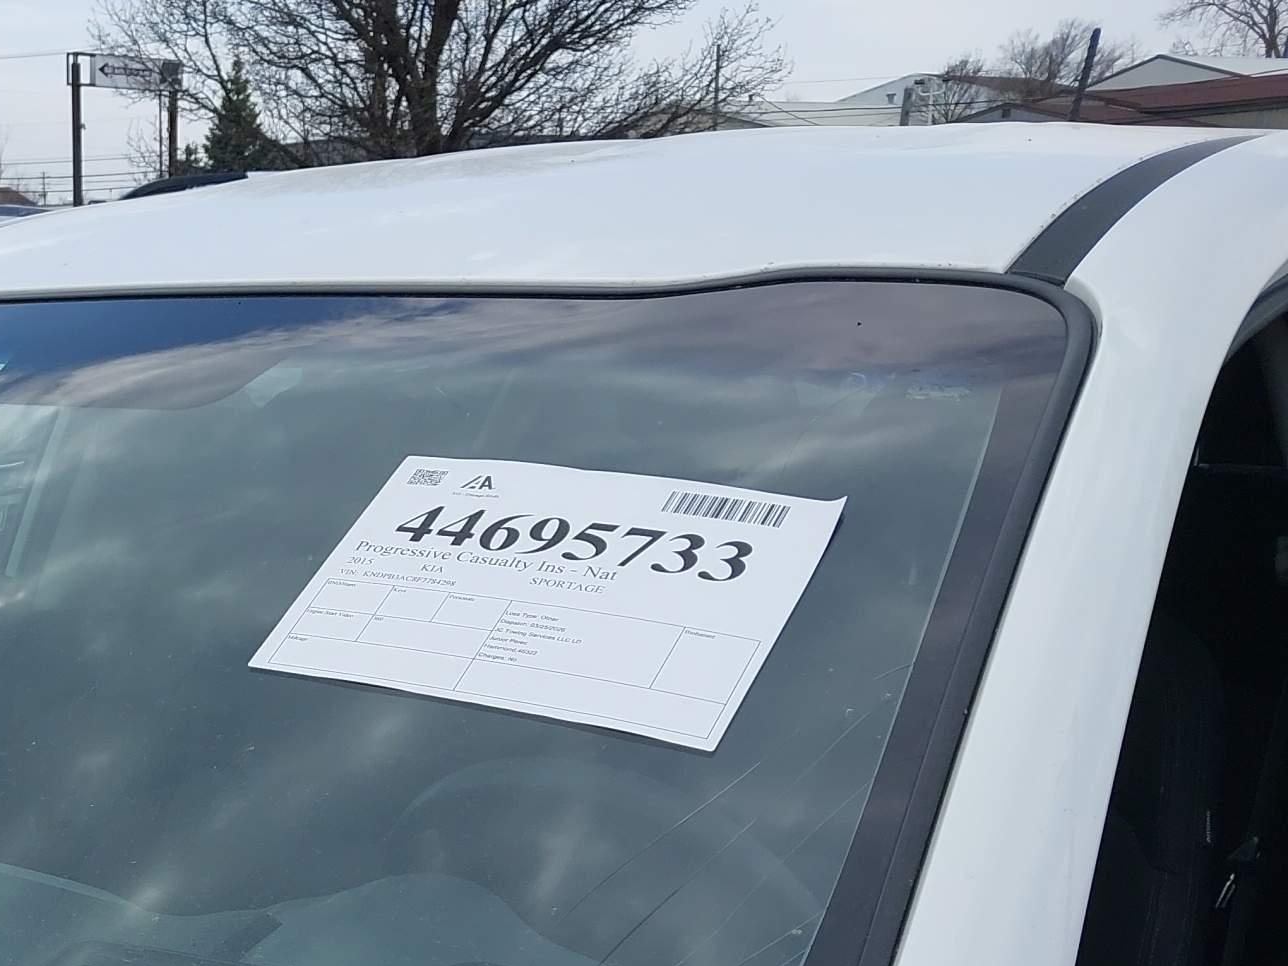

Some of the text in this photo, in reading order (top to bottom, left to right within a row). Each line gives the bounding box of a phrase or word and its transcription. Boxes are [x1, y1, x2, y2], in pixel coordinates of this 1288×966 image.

[356, 540, 453, 561] Progressive
[456, 550, 534, 572] Casualty
[536, 560, 566, 574] Ins
[582, 565, 618, 581] Nat
[395, 505, 754, 582] 44695733
[346, 556, 606, 594] 2015 KIA SPORTAGE
